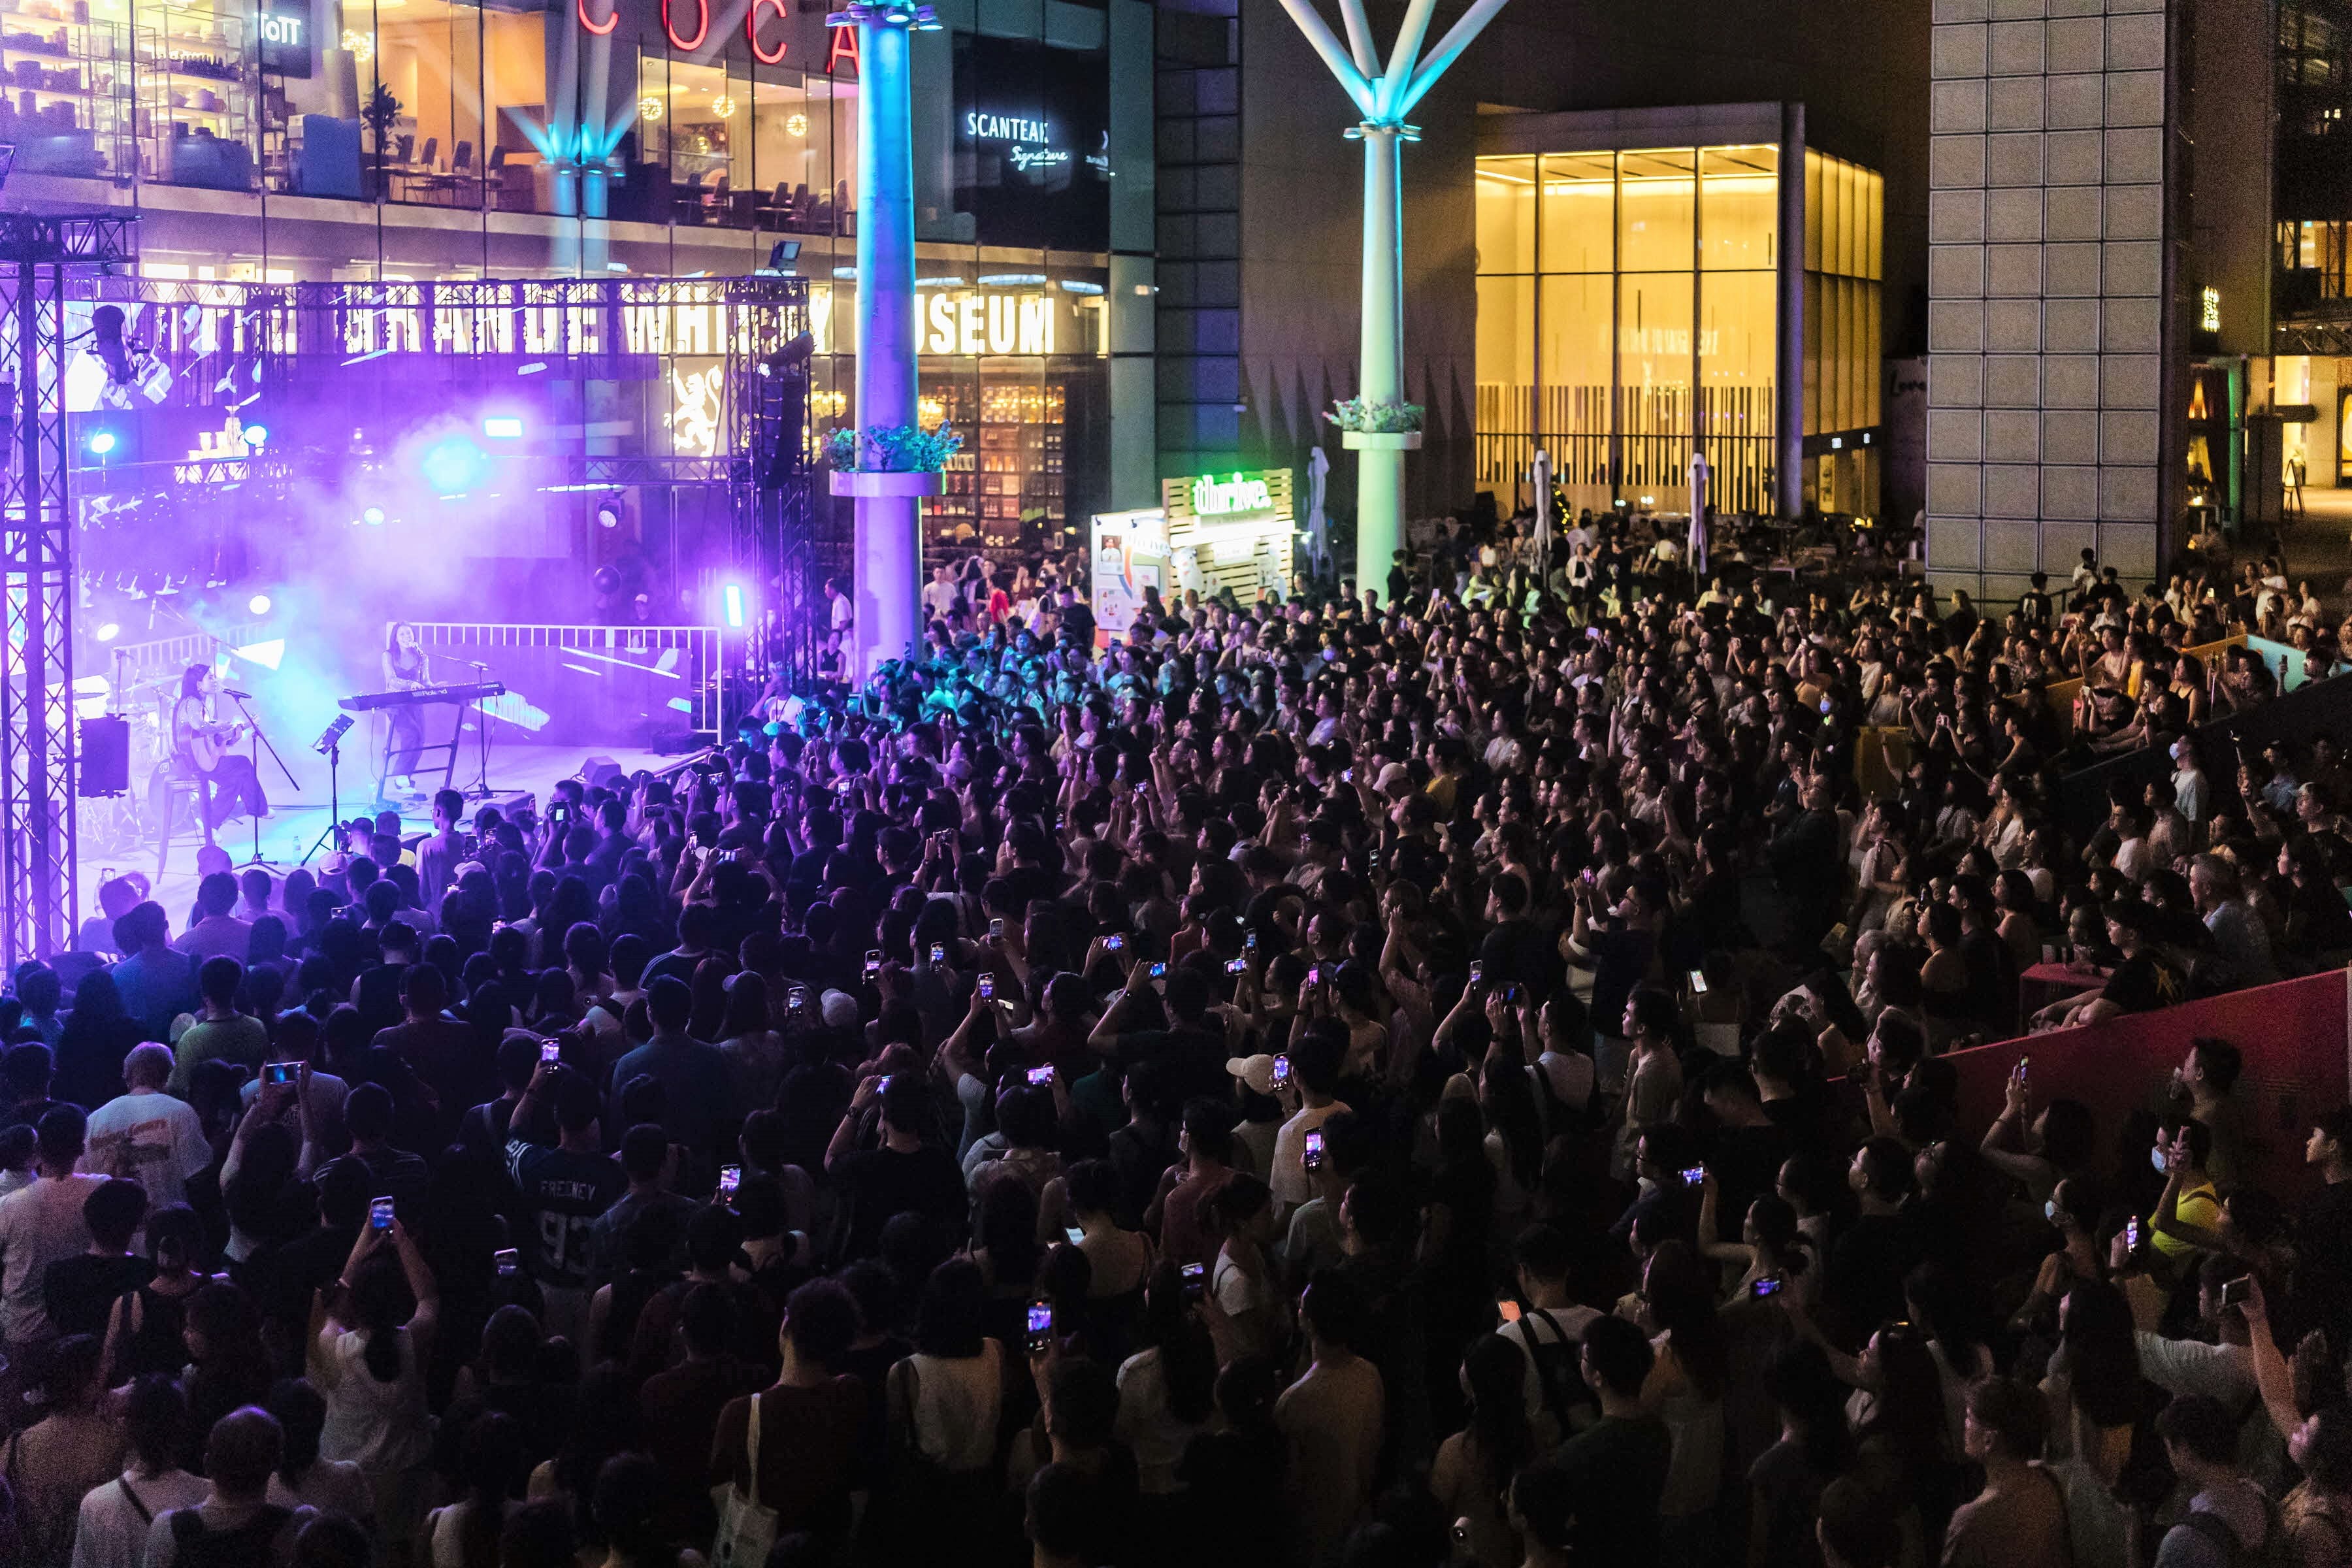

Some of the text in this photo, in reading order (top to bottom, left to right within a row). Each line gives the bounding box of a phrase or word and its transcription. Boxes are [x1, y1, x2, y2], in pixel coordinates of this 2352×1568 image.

[253, 11, 301, 45] ToTT
[968, 112, 1049, 144] SCANTEAK
[1009, 145, 1068, 171] Signature
[855, 291, 1055, 355] SEUM
[540, 1180, 596, 1201] FREENEY
